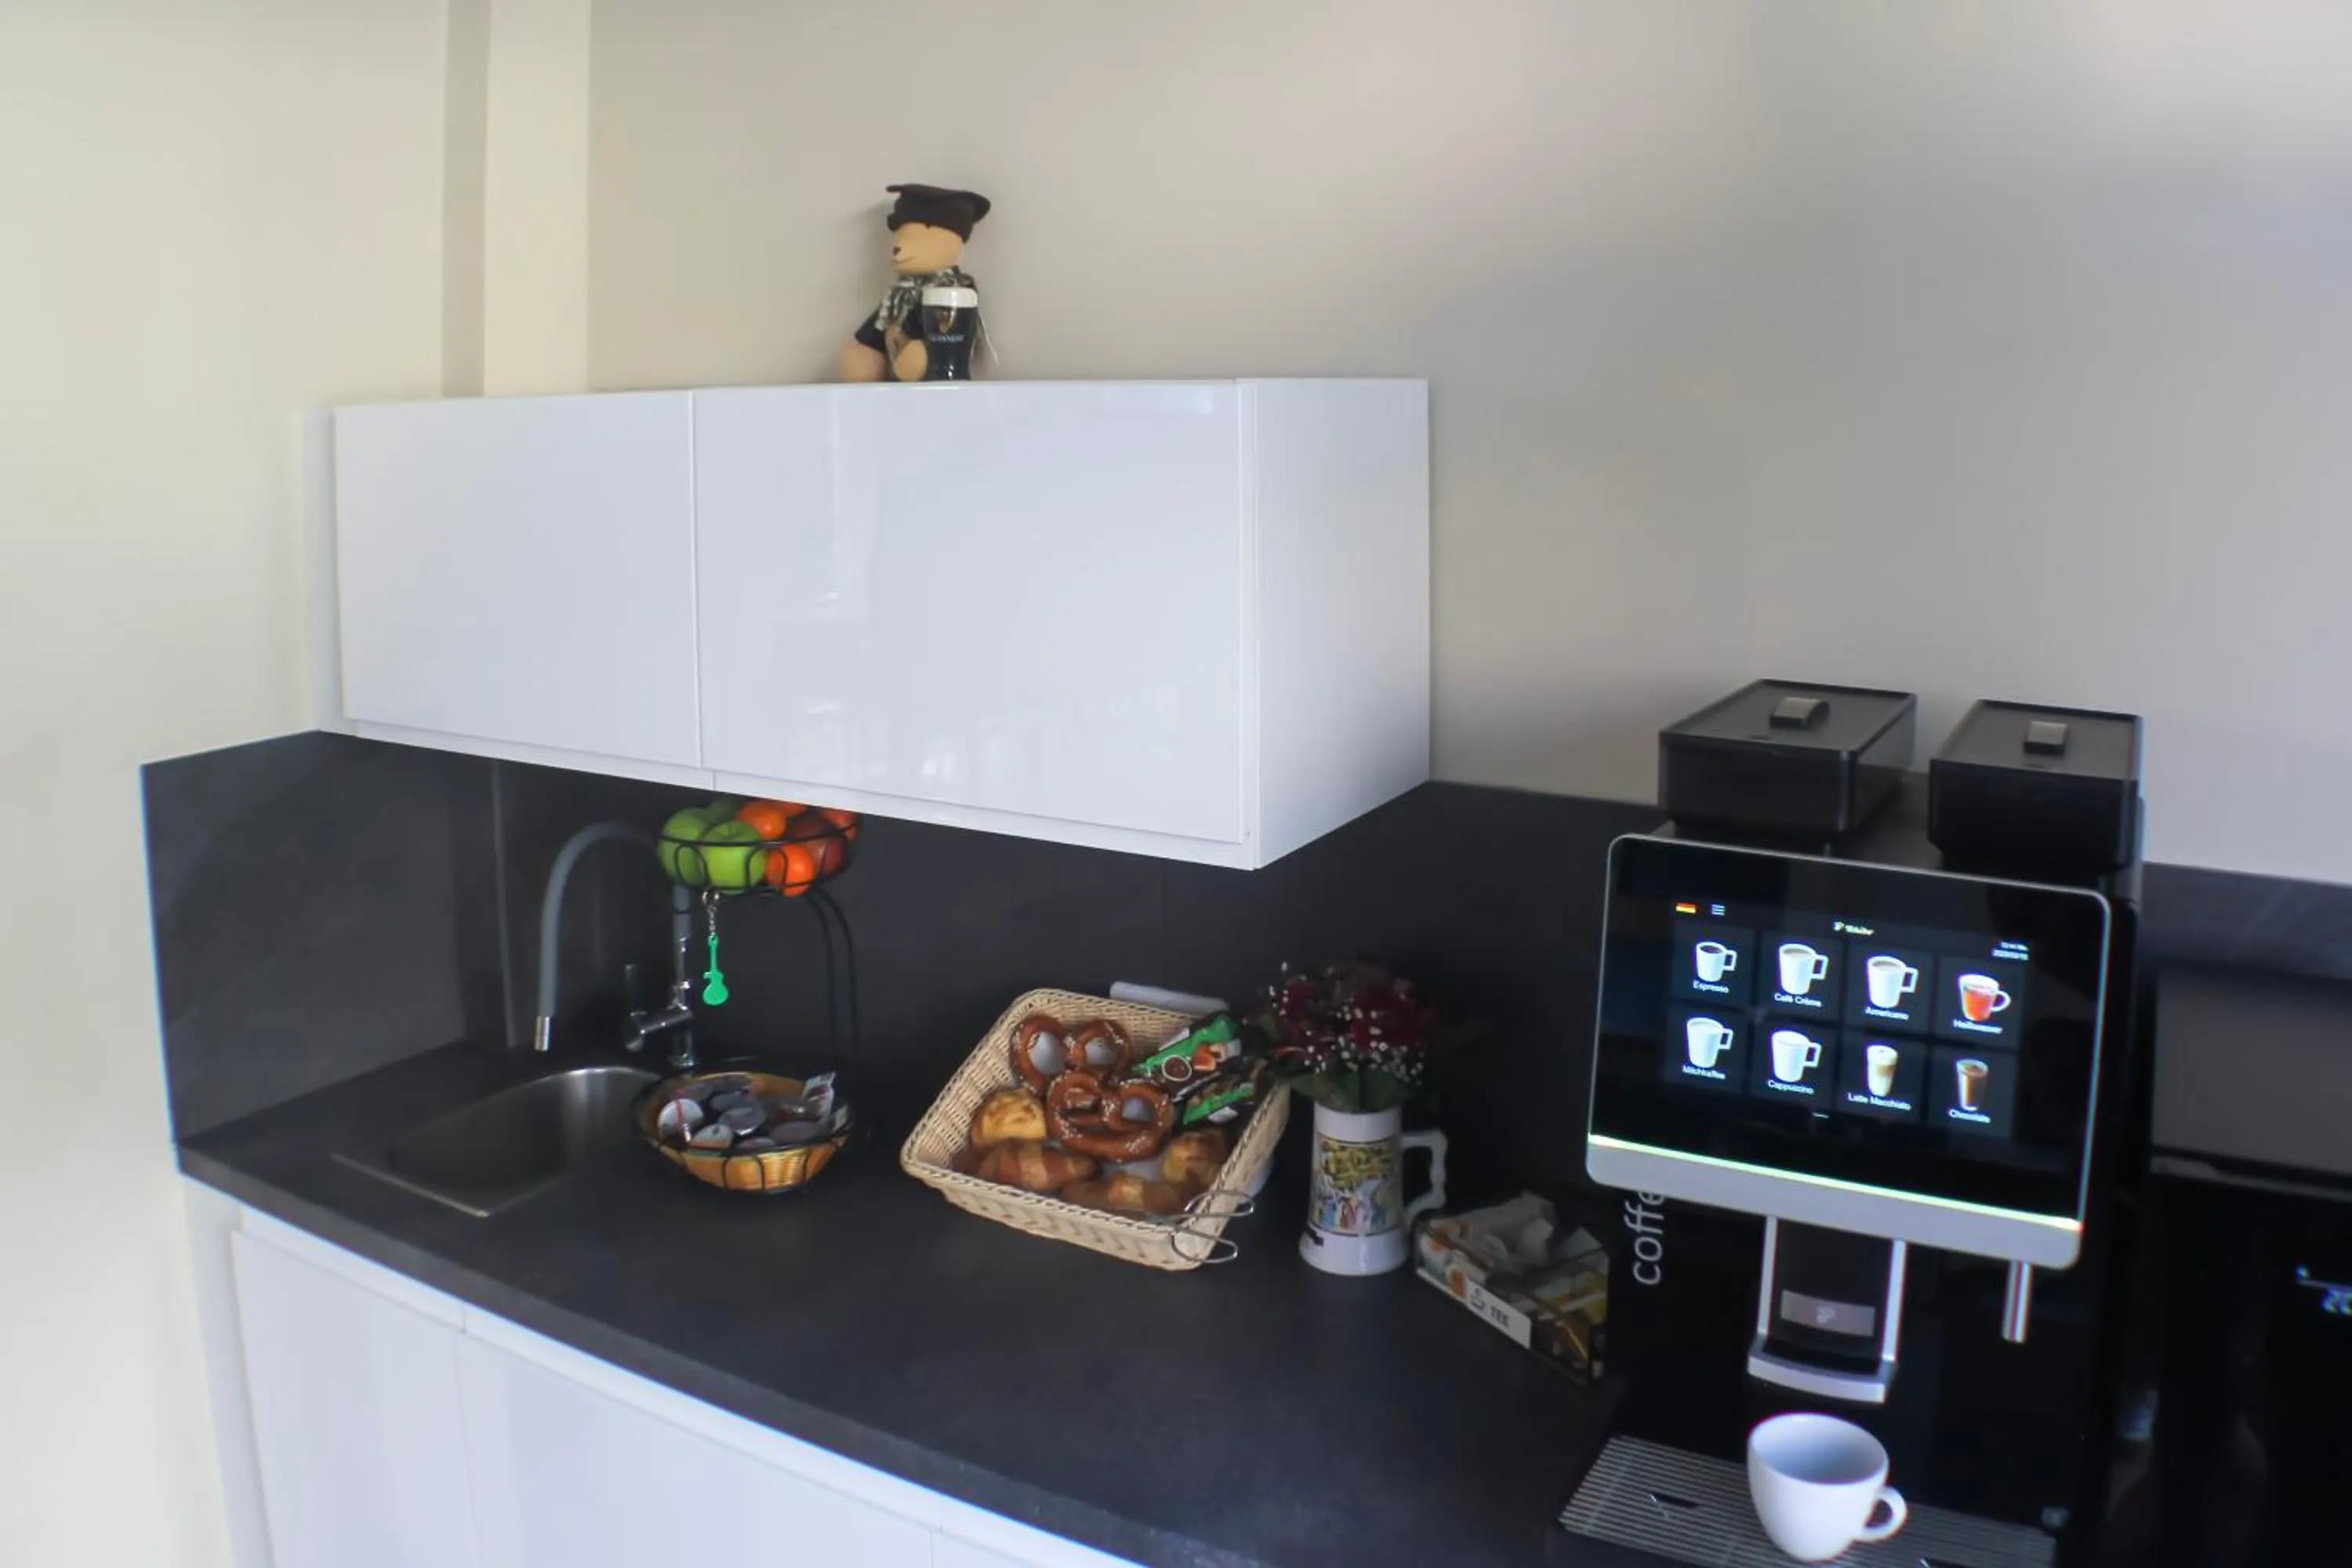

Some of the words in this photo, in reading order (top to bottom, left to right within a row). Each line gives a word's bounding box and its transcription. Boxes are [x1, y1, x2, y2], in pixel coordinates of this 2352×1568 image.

[1693, 980, 1729, 993] Espresso
[1865, 1006, 1908, 1020] Americano
[1768, 1080, 1813, 1094] Cappuccino
[1847, 1092, 1868, 1104] Latte
